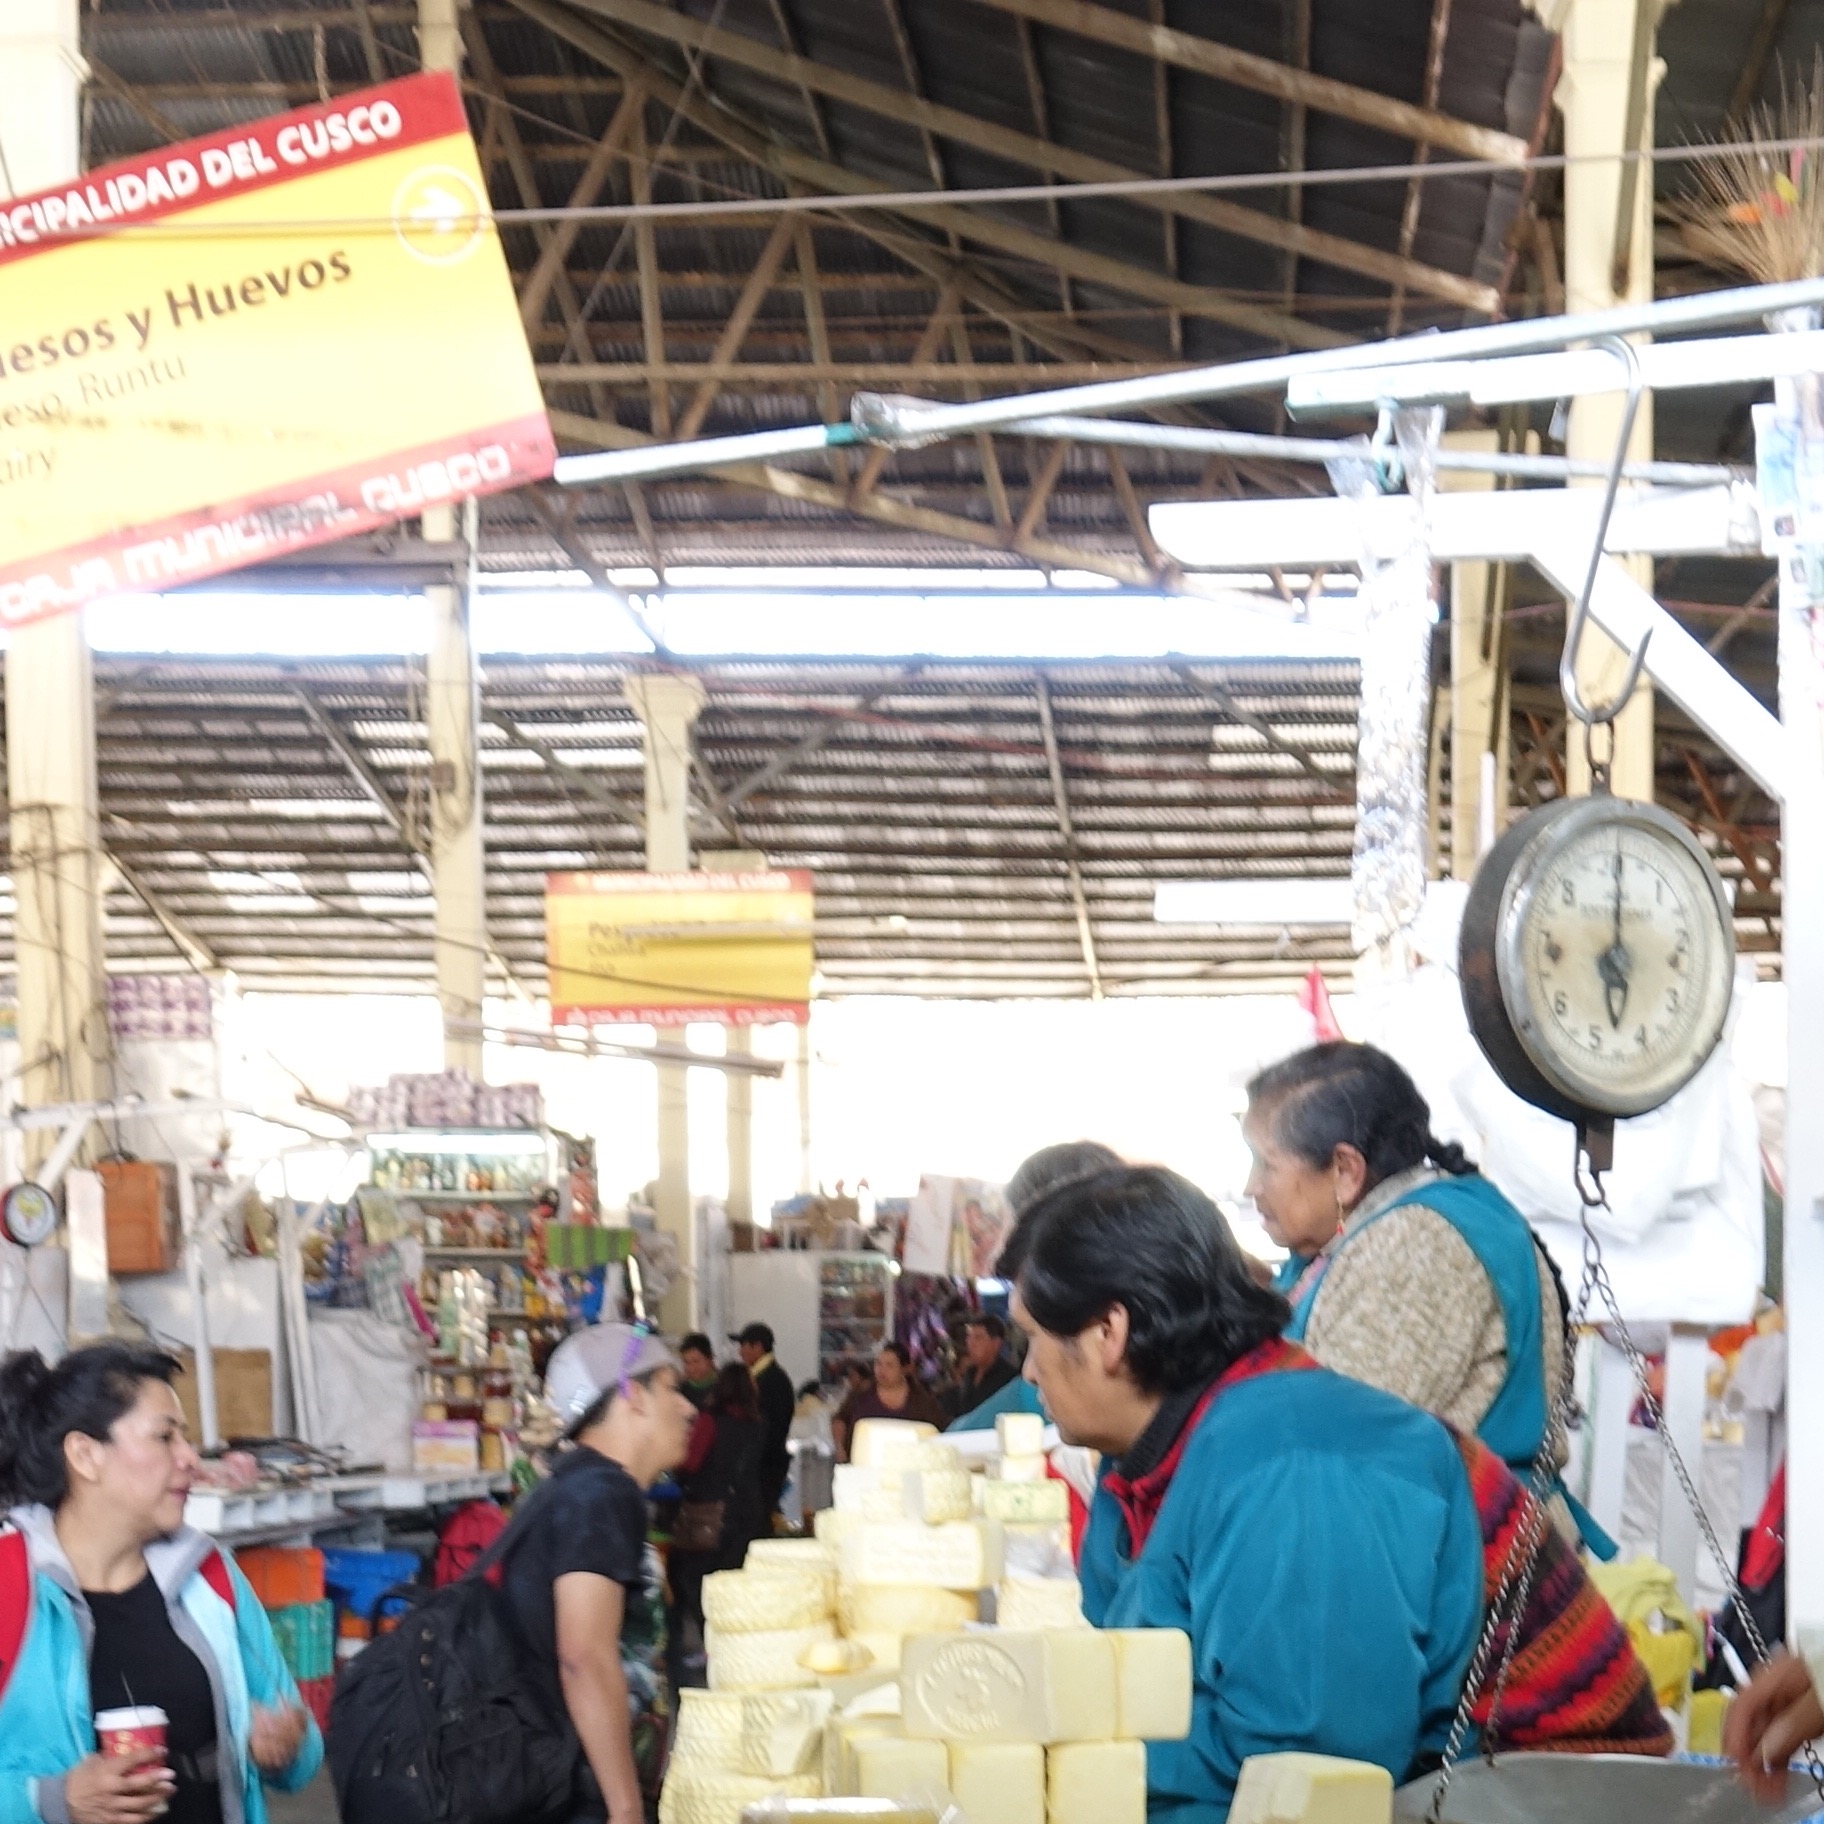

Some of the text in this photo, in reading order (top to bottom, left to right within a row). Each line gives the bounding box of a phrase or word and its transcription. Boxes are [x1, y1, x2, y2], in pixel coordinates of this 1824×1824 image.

[201, 138, 276, 188] DEL
[277, 100, 402, 165] CUSCO
[125, 305, 152, 350] y
[164, 250, 353, 328] Huevos
[78, 353, 187, 406] Runtu
[360, 444, 511, 512] CUSCO
